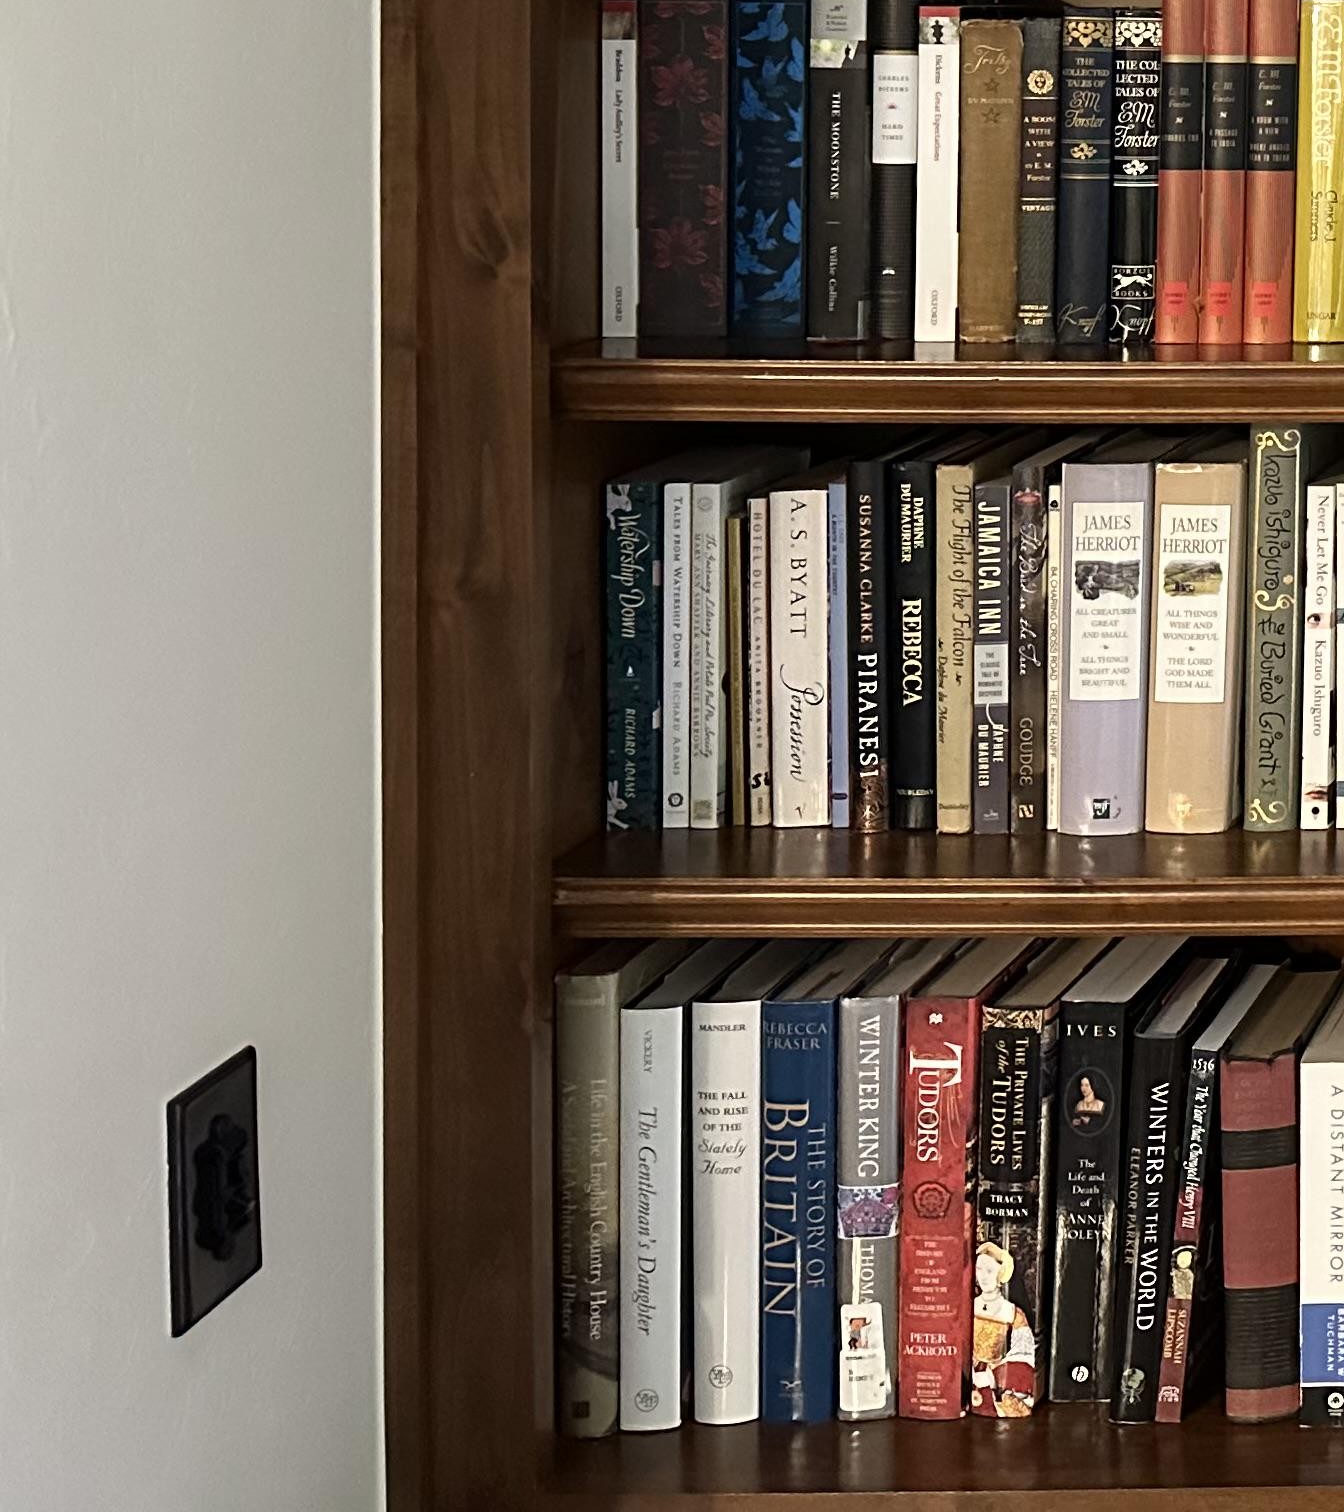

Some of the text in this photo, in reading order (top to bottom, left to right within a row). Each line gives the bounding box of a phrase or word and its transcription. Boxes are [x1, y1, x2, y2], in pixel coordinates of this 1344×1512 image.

[830, 92, 842, 200] THE MOONSTONE
[977, 501, 1000, 635] JAMAICA INN
[1075, 536, 1140, 552] HERRIOT
[1083, 515, 1131, 531] JAMES
[790, 558, 808, 639] BYATT
[902, 599, 922, 706] REBECCA
[858, 653, 879, 778] PIRANESI
[858, 1015, 880, 1178] WINTER KING
[909, 1042, 962, 1163] TUDORS
[763, 1099, 809, 1318] BRITAIN
[1329, 1084, 1344, 1285] A DISTANT MIRROR
